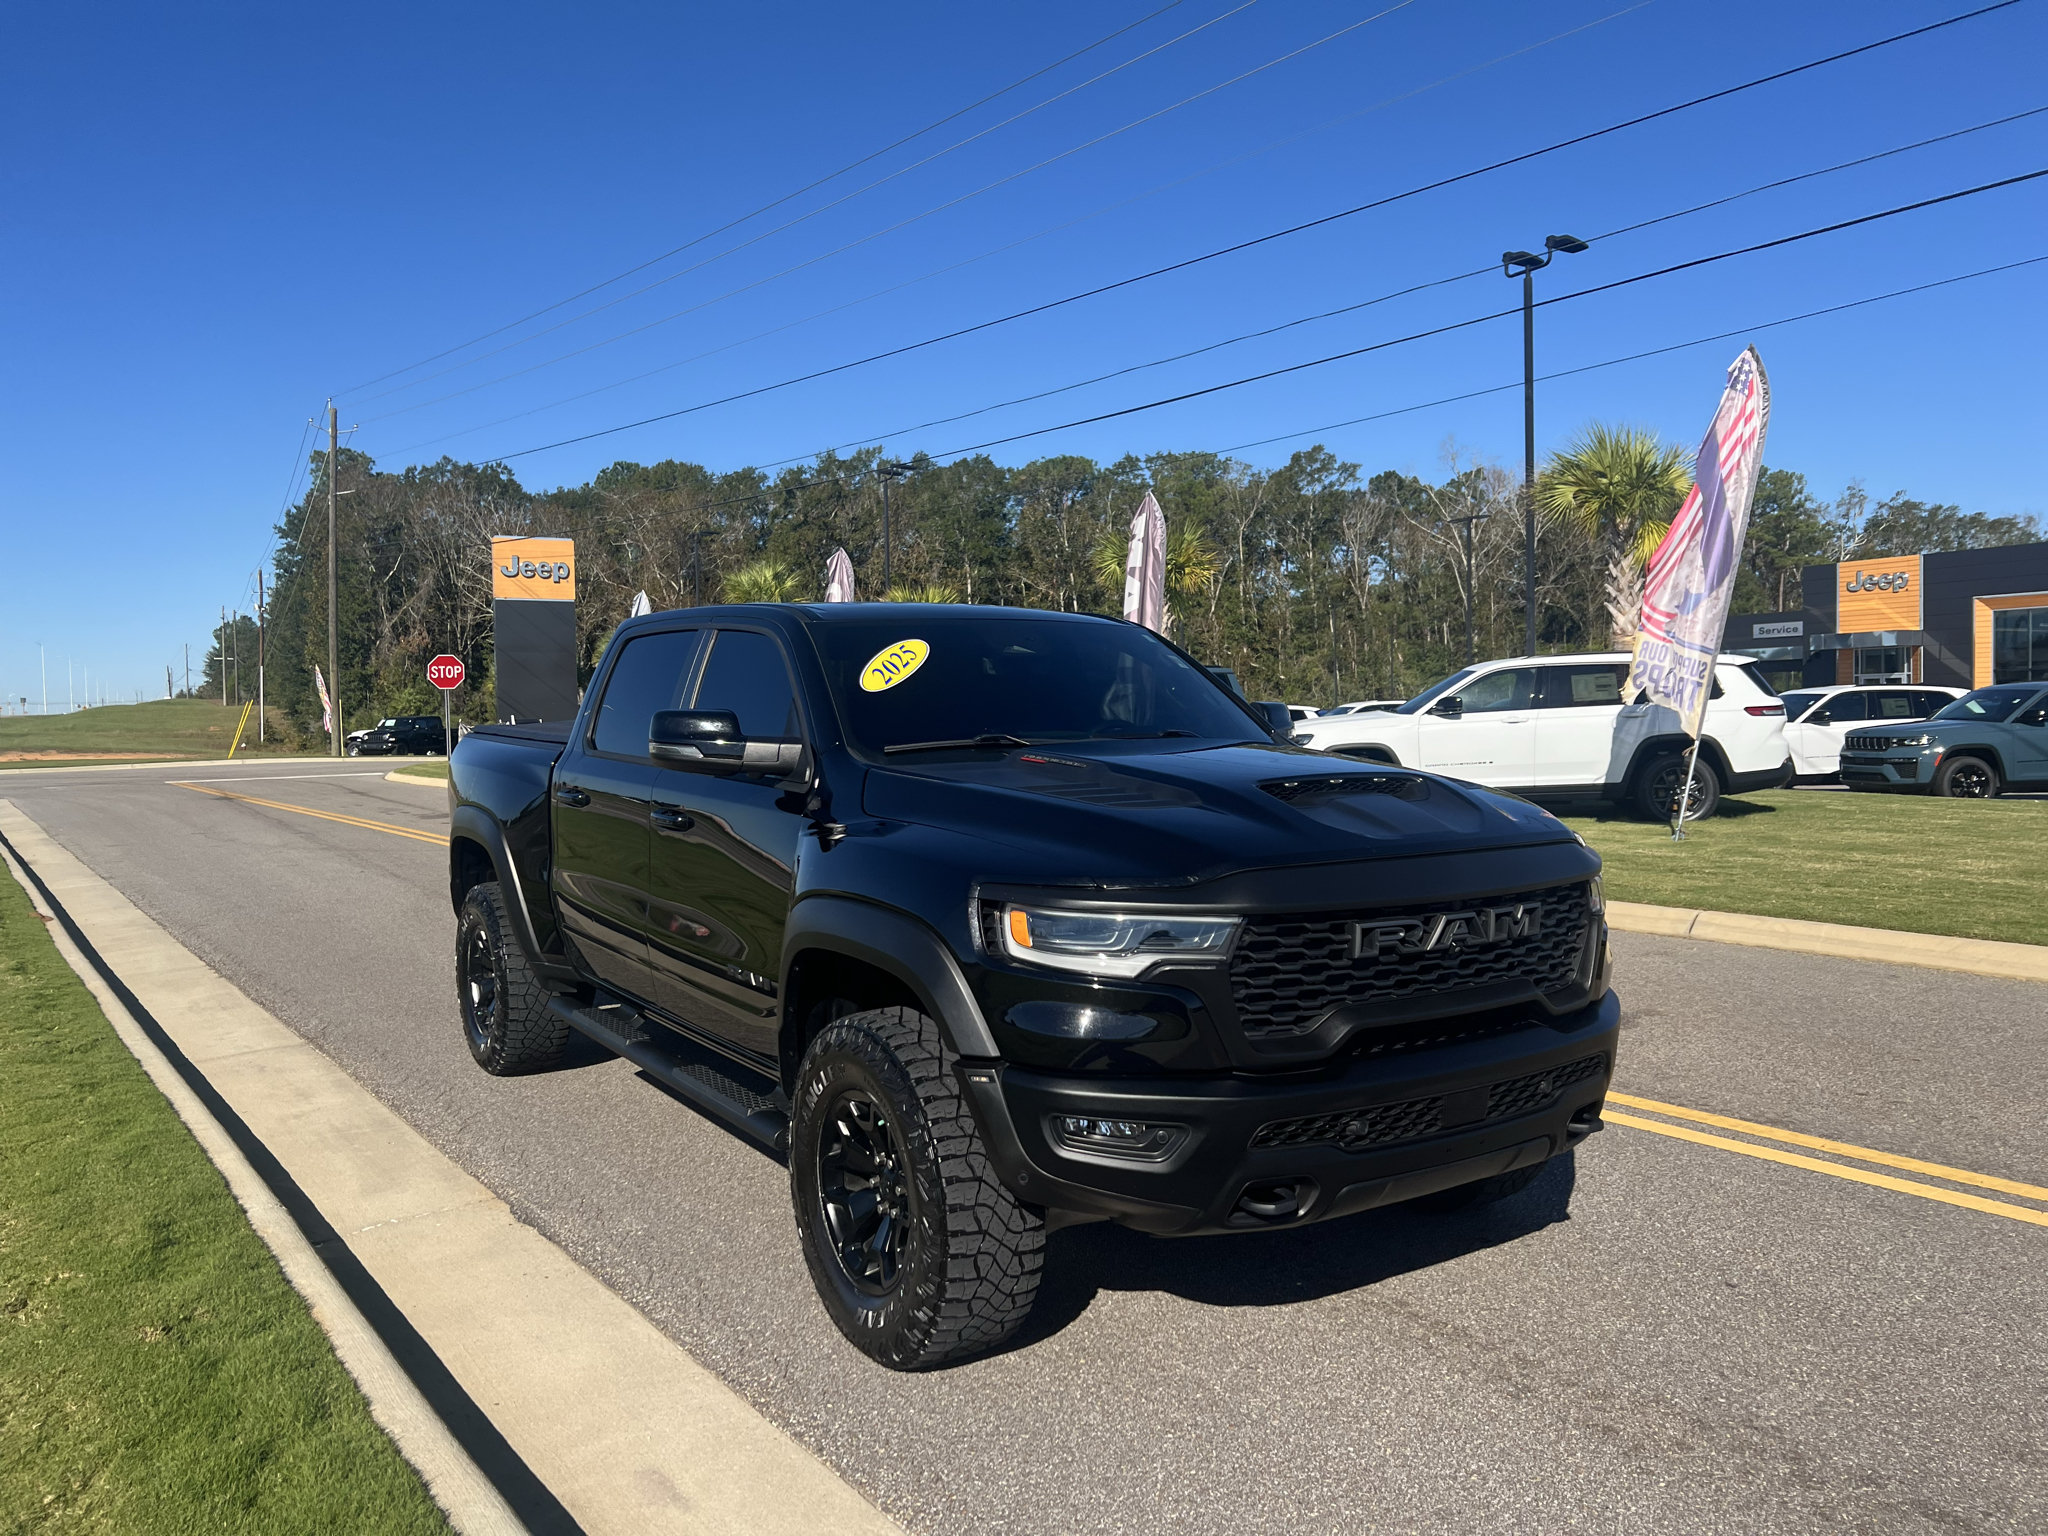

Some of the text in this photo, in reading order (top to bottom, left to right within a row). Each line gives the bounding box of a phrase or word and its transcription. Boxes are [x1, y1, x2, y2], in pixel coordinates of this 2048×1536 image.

[501, 555, 570, 584] Jeep
[1847, 570, 1910, 593] Jeep
[1758, 625, 1799, 636] Service
[430, 665, 462, 679] STOP
[871, 644, 917, 685] 2025
[1353, 902, 1542, 959] RAM
